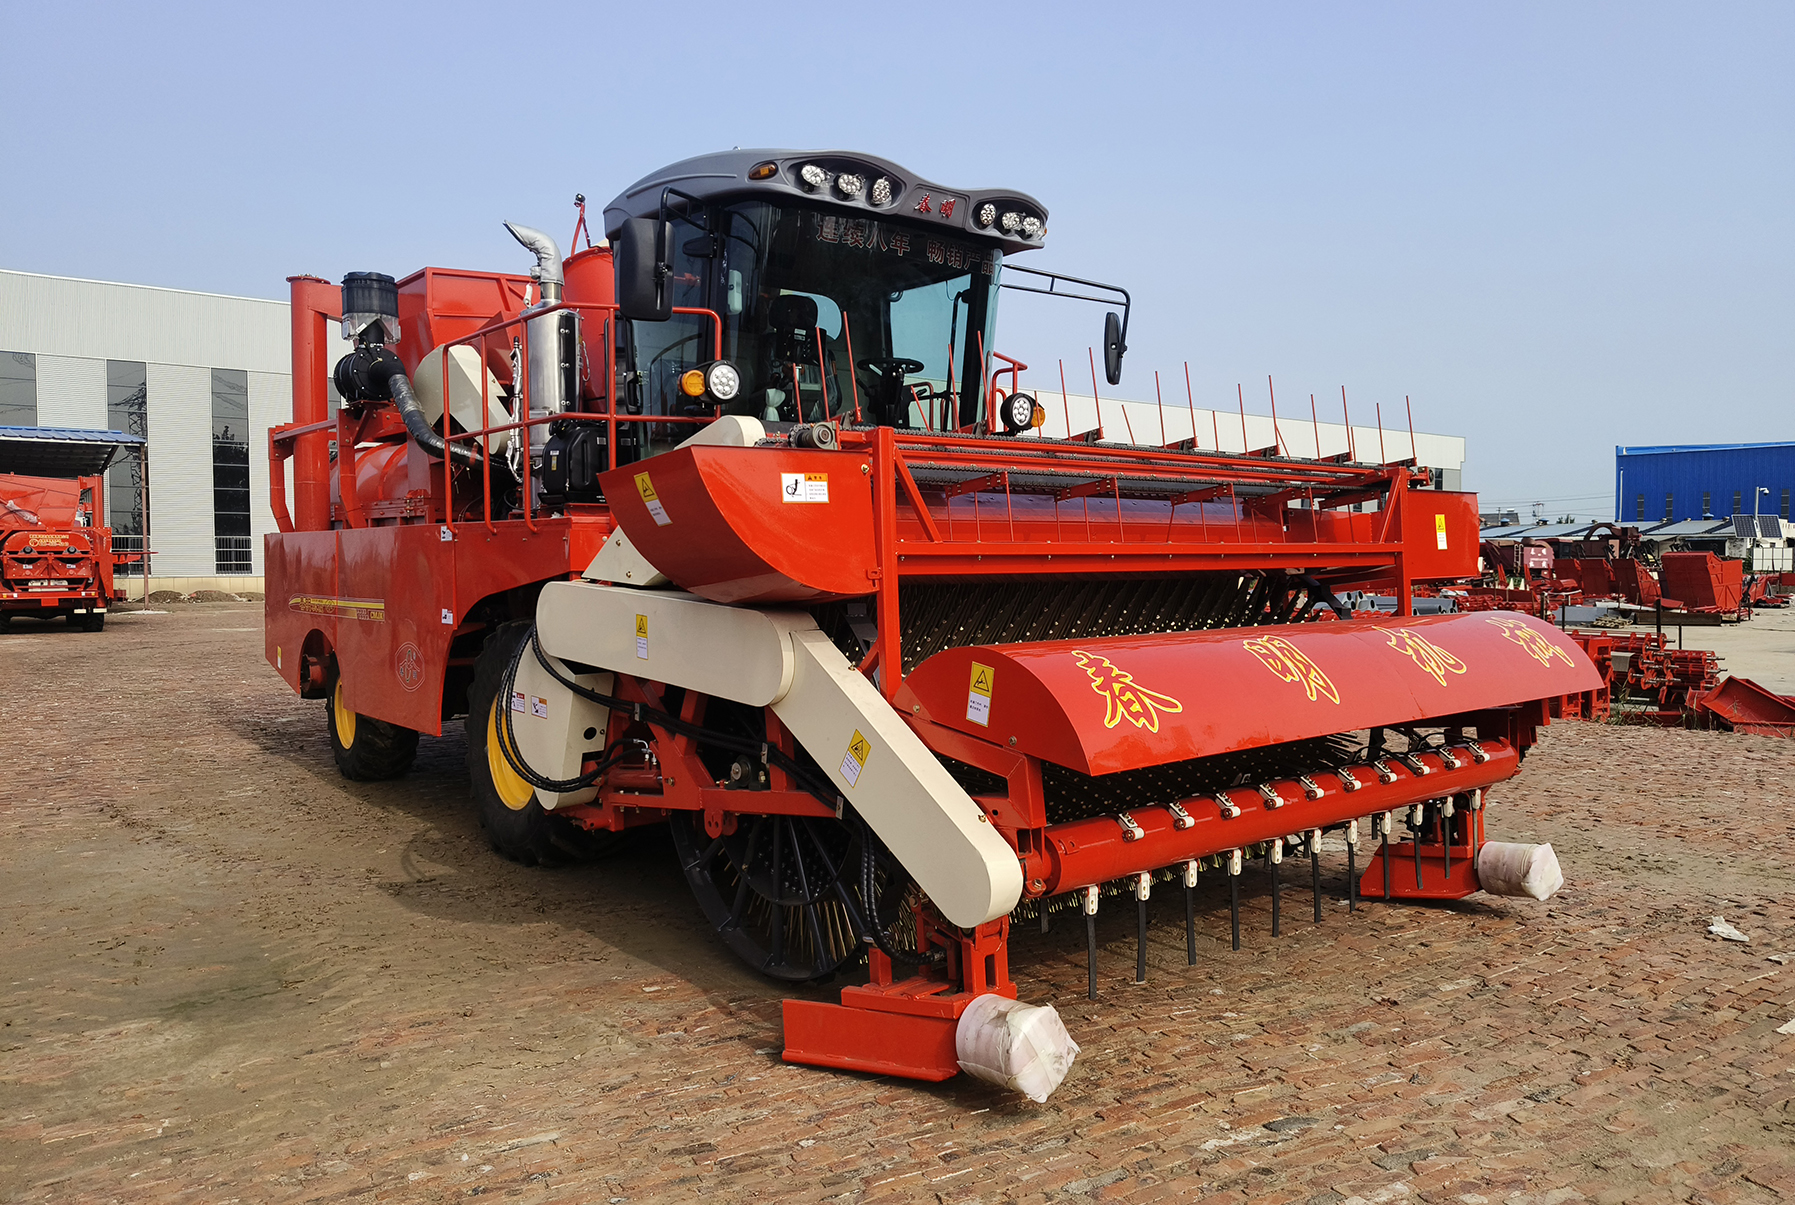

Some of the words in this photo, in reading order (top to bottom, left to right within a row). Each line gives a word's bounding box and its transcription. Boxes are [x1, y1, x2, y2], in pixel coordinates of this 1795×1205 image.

[914, 193, 956, 218] 春明
[816, 216, 910, 256] 连续八年
[927, 238, 995, 276] 畅销产品
